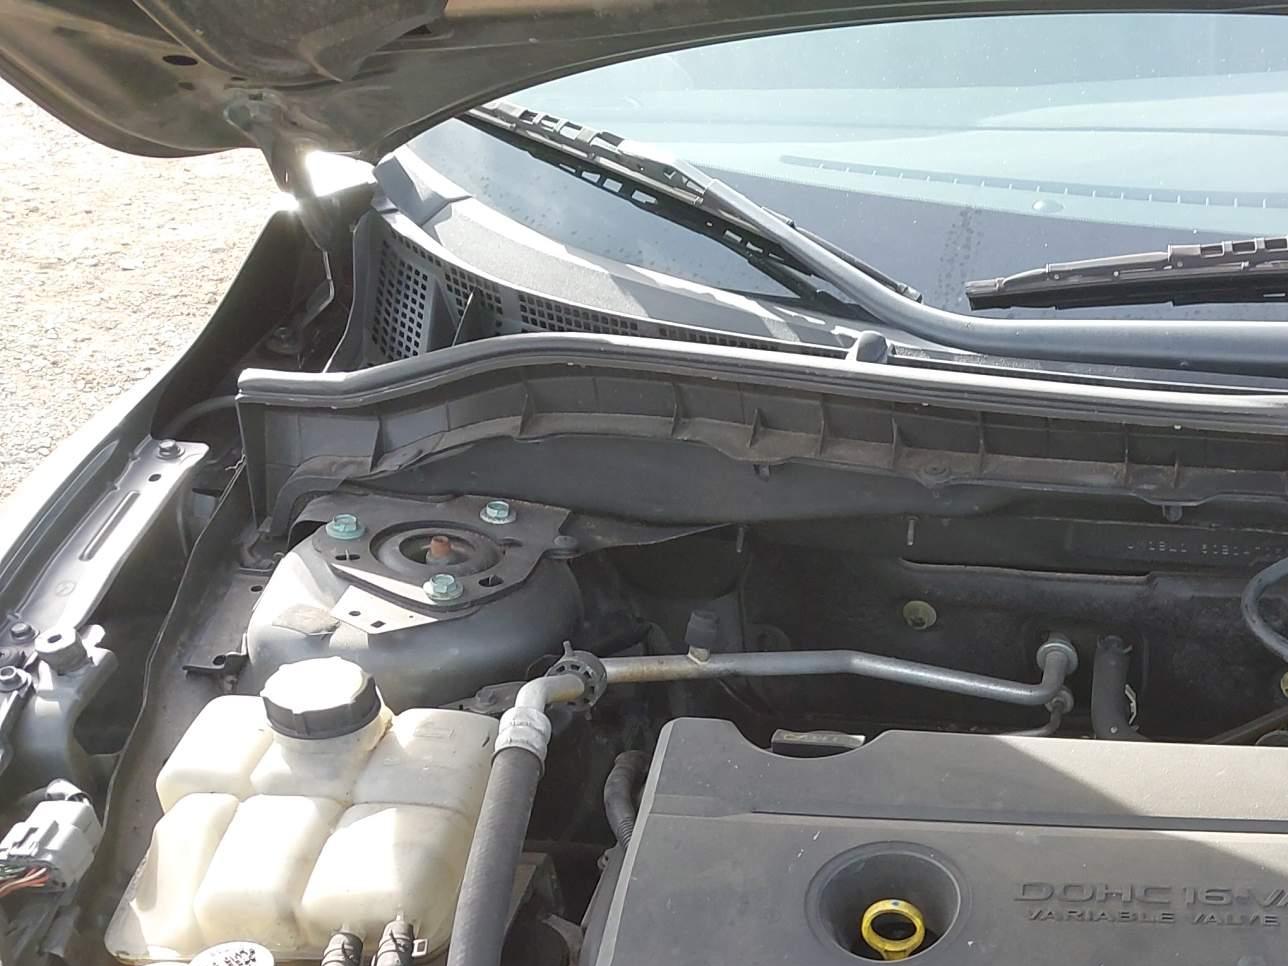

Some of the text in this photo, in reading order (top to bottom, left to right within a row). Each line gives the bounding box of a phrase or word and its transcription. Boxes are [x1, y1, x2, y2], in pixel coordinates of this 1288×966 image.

[1012, 881, 1172, 906] DOHC
[1027, 907, 1177, 925] VARIABLE
[1191, 912, 1281, 928] VALVE
